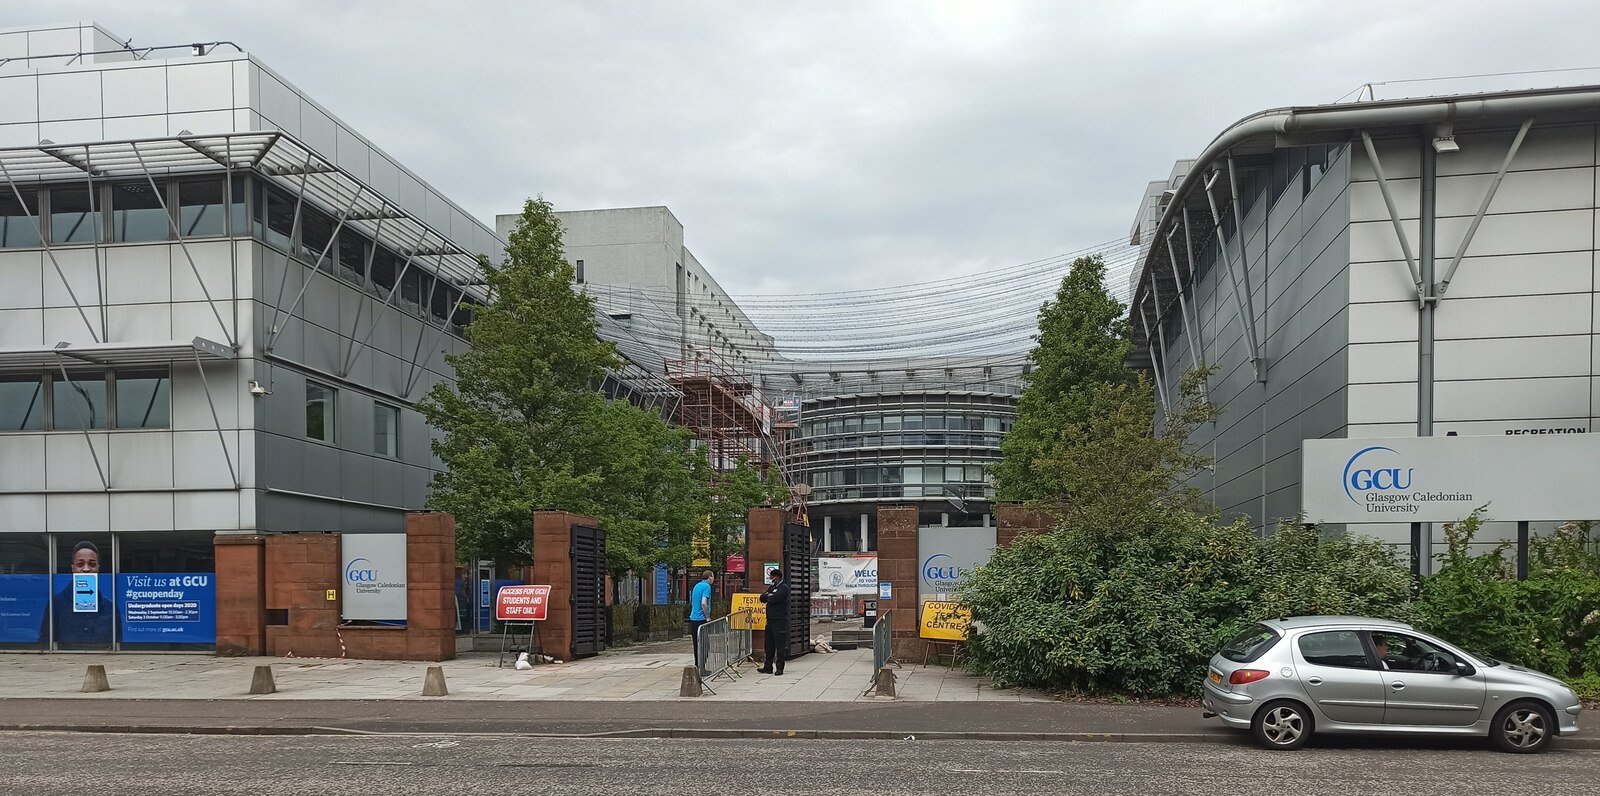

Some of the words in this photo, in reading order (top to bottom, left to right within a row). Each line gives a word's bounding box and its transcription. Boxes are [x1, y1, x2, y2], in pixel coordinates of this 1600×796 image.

[1351, 468, 1414, 490] GCU
[1366, 492, 1410, 503] Glasgow
[1412, 492, 1472, 502] Caledonian
[1366, 503, 1420, 514] University
[350, 570, 378, 582] GCU
[927, 566, 960, 579] GCU
[126, 576, 151, 587] Visit
[154, 578, 167, 587] us
[169, 576, 181, 587] at
[183, 576, 208, 587] GCU
[126, 589, 184, 600] #gcuopenday
[506, 606, 522, 614] STAFF
[522, 606, 537, 614] ONLY
[926, 621, 962, 630] CENTRE
